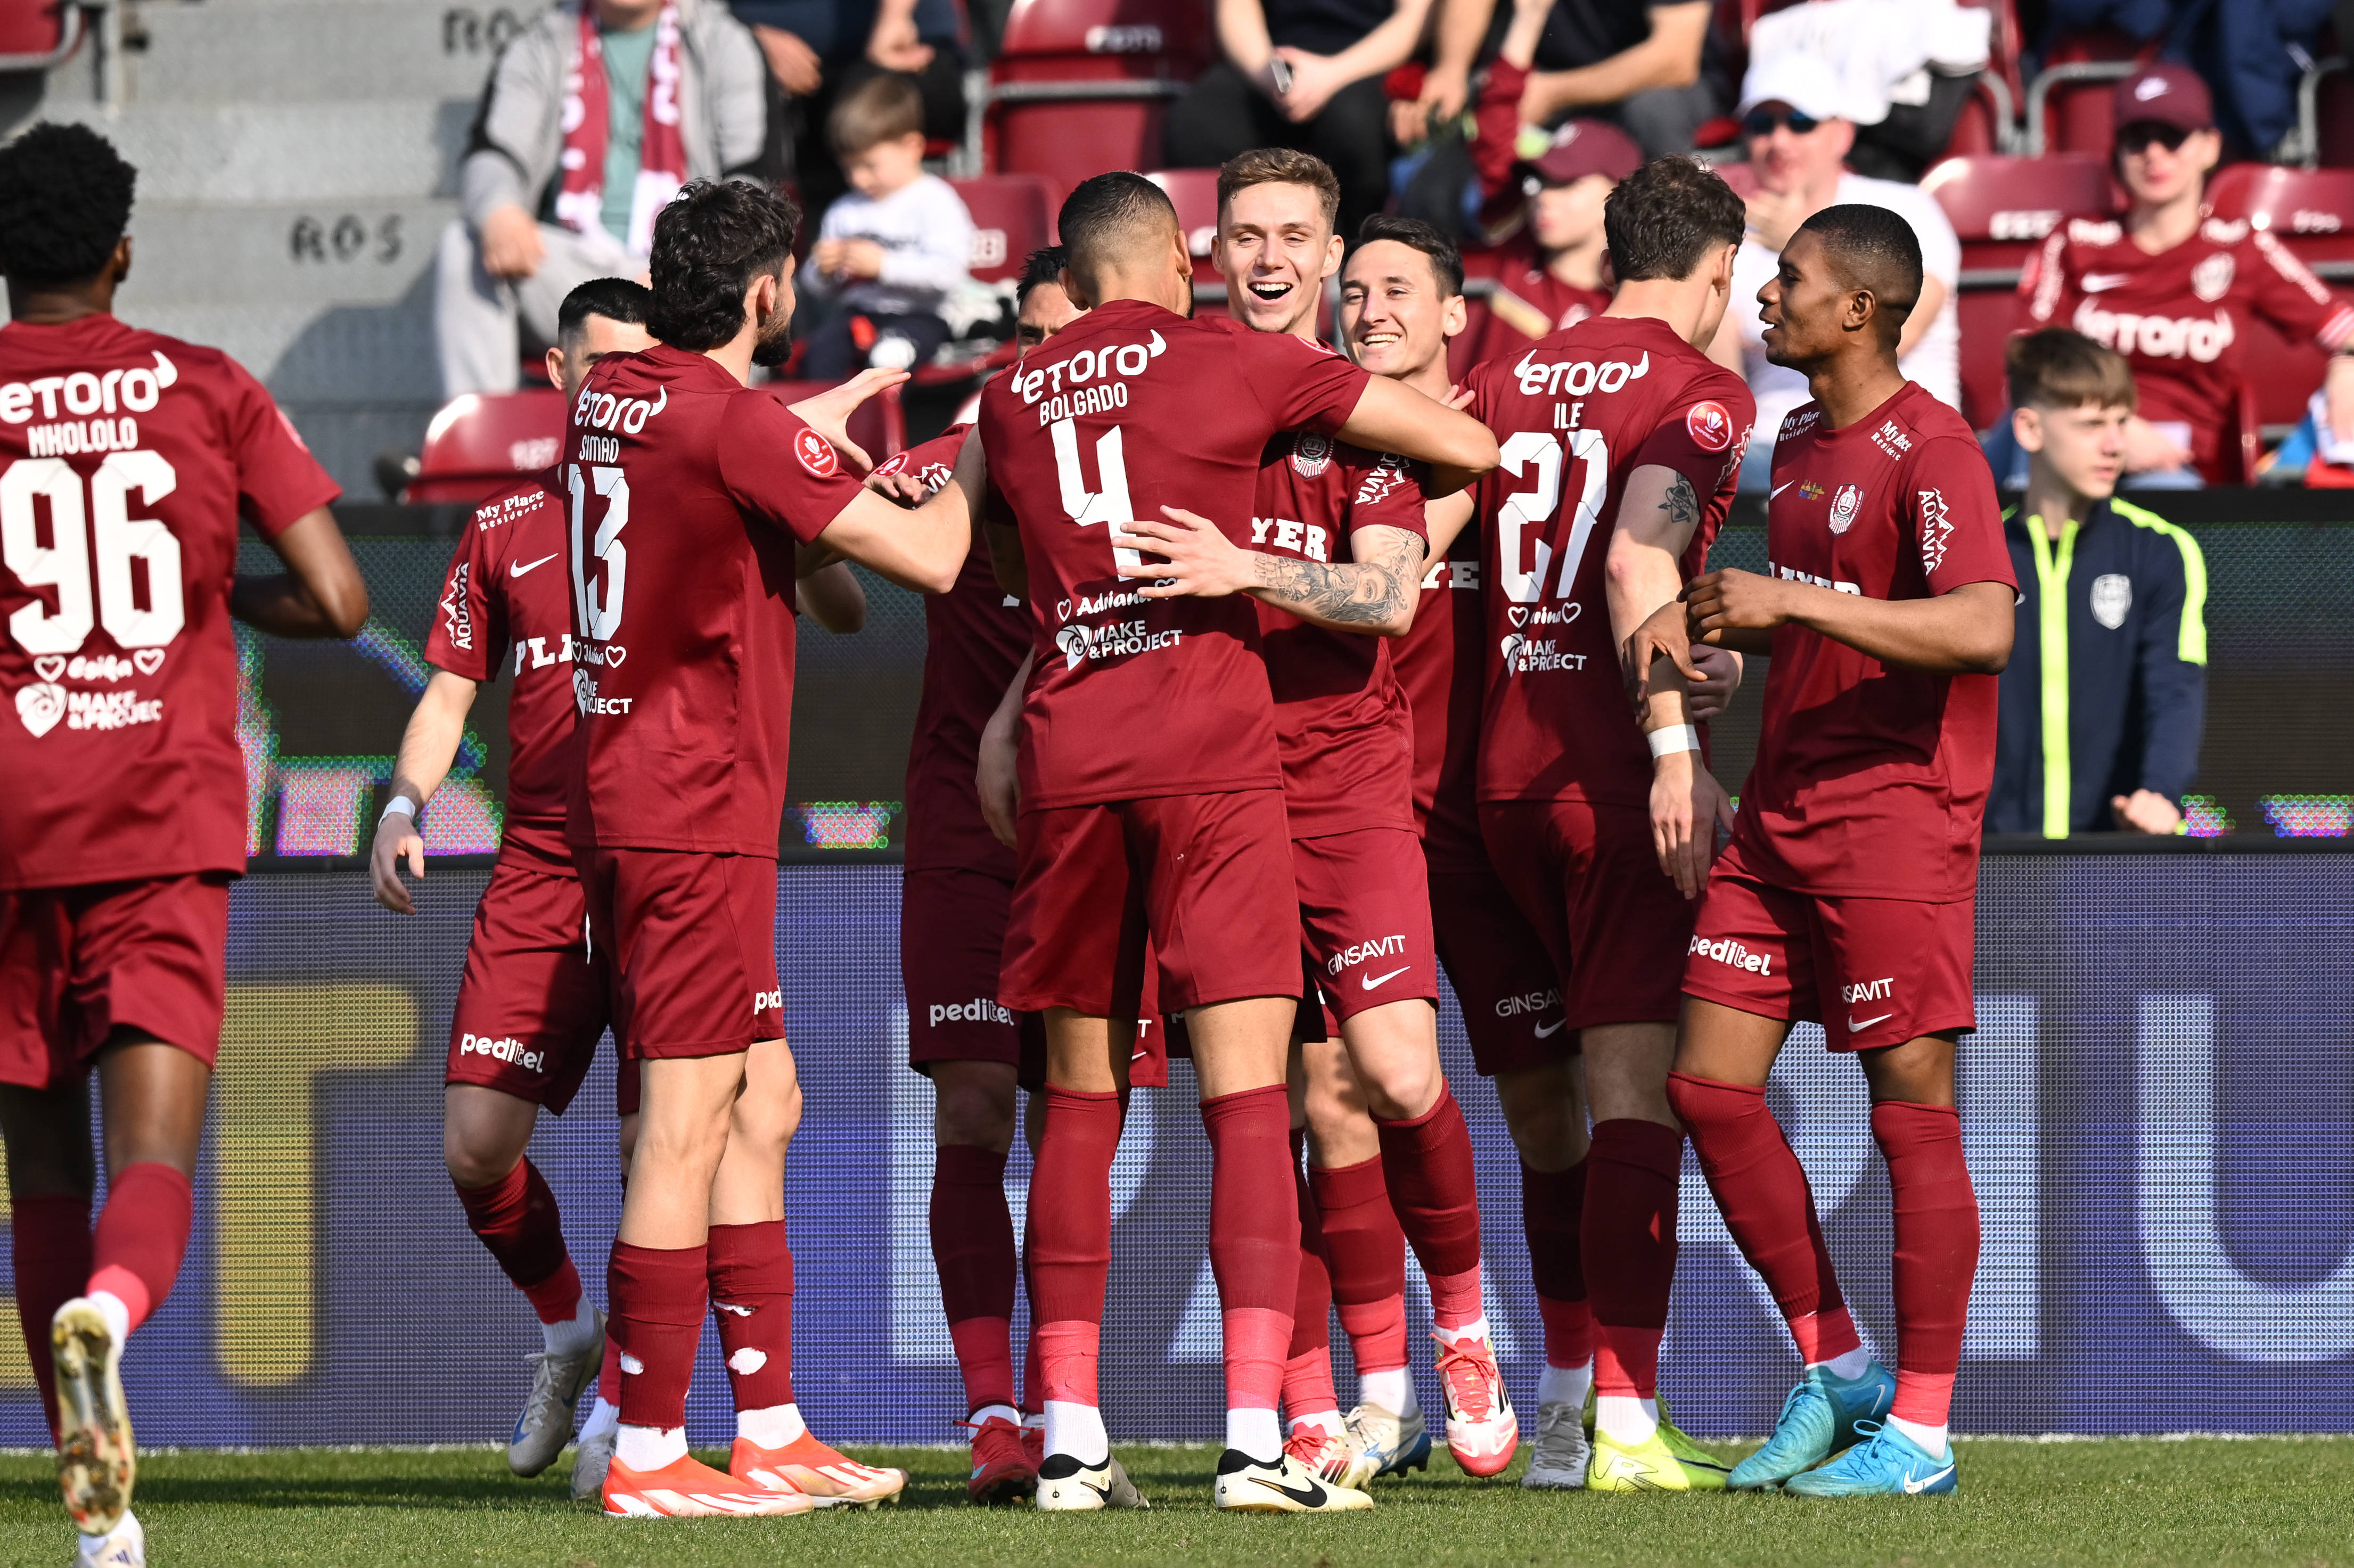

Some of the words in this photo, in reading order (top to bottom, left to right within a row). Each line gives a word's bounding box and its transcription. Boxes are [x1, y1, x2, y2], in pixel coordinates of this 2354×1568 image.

[1040, 382, 1128, 426] BOLGADO
[1554, 403, 1585, 429] ILE
[1880, 420, 1899, 441] My
[475, 504, 501, 522] My
[503, 490, 544, 512] Place
[1051, 417, 1143, 582] 4
[1497, 431, 1609, 603] 27
[0, 450, 185, 654] 96
[569, 463, 630, 641] 13
[1918, 490, 1937, 577] AQUAVIA
[455, 562, 473, 651] AQUAVIA
[1088, 629, 1183, 659] &PROJECT
[1092, 620, 1147, 644] MAKE
[1328, 935, 1406, 976] GINSAVIT
[1687, 934, 1771, 976] peditel
[460, 1032, 544, 1073] peditel
